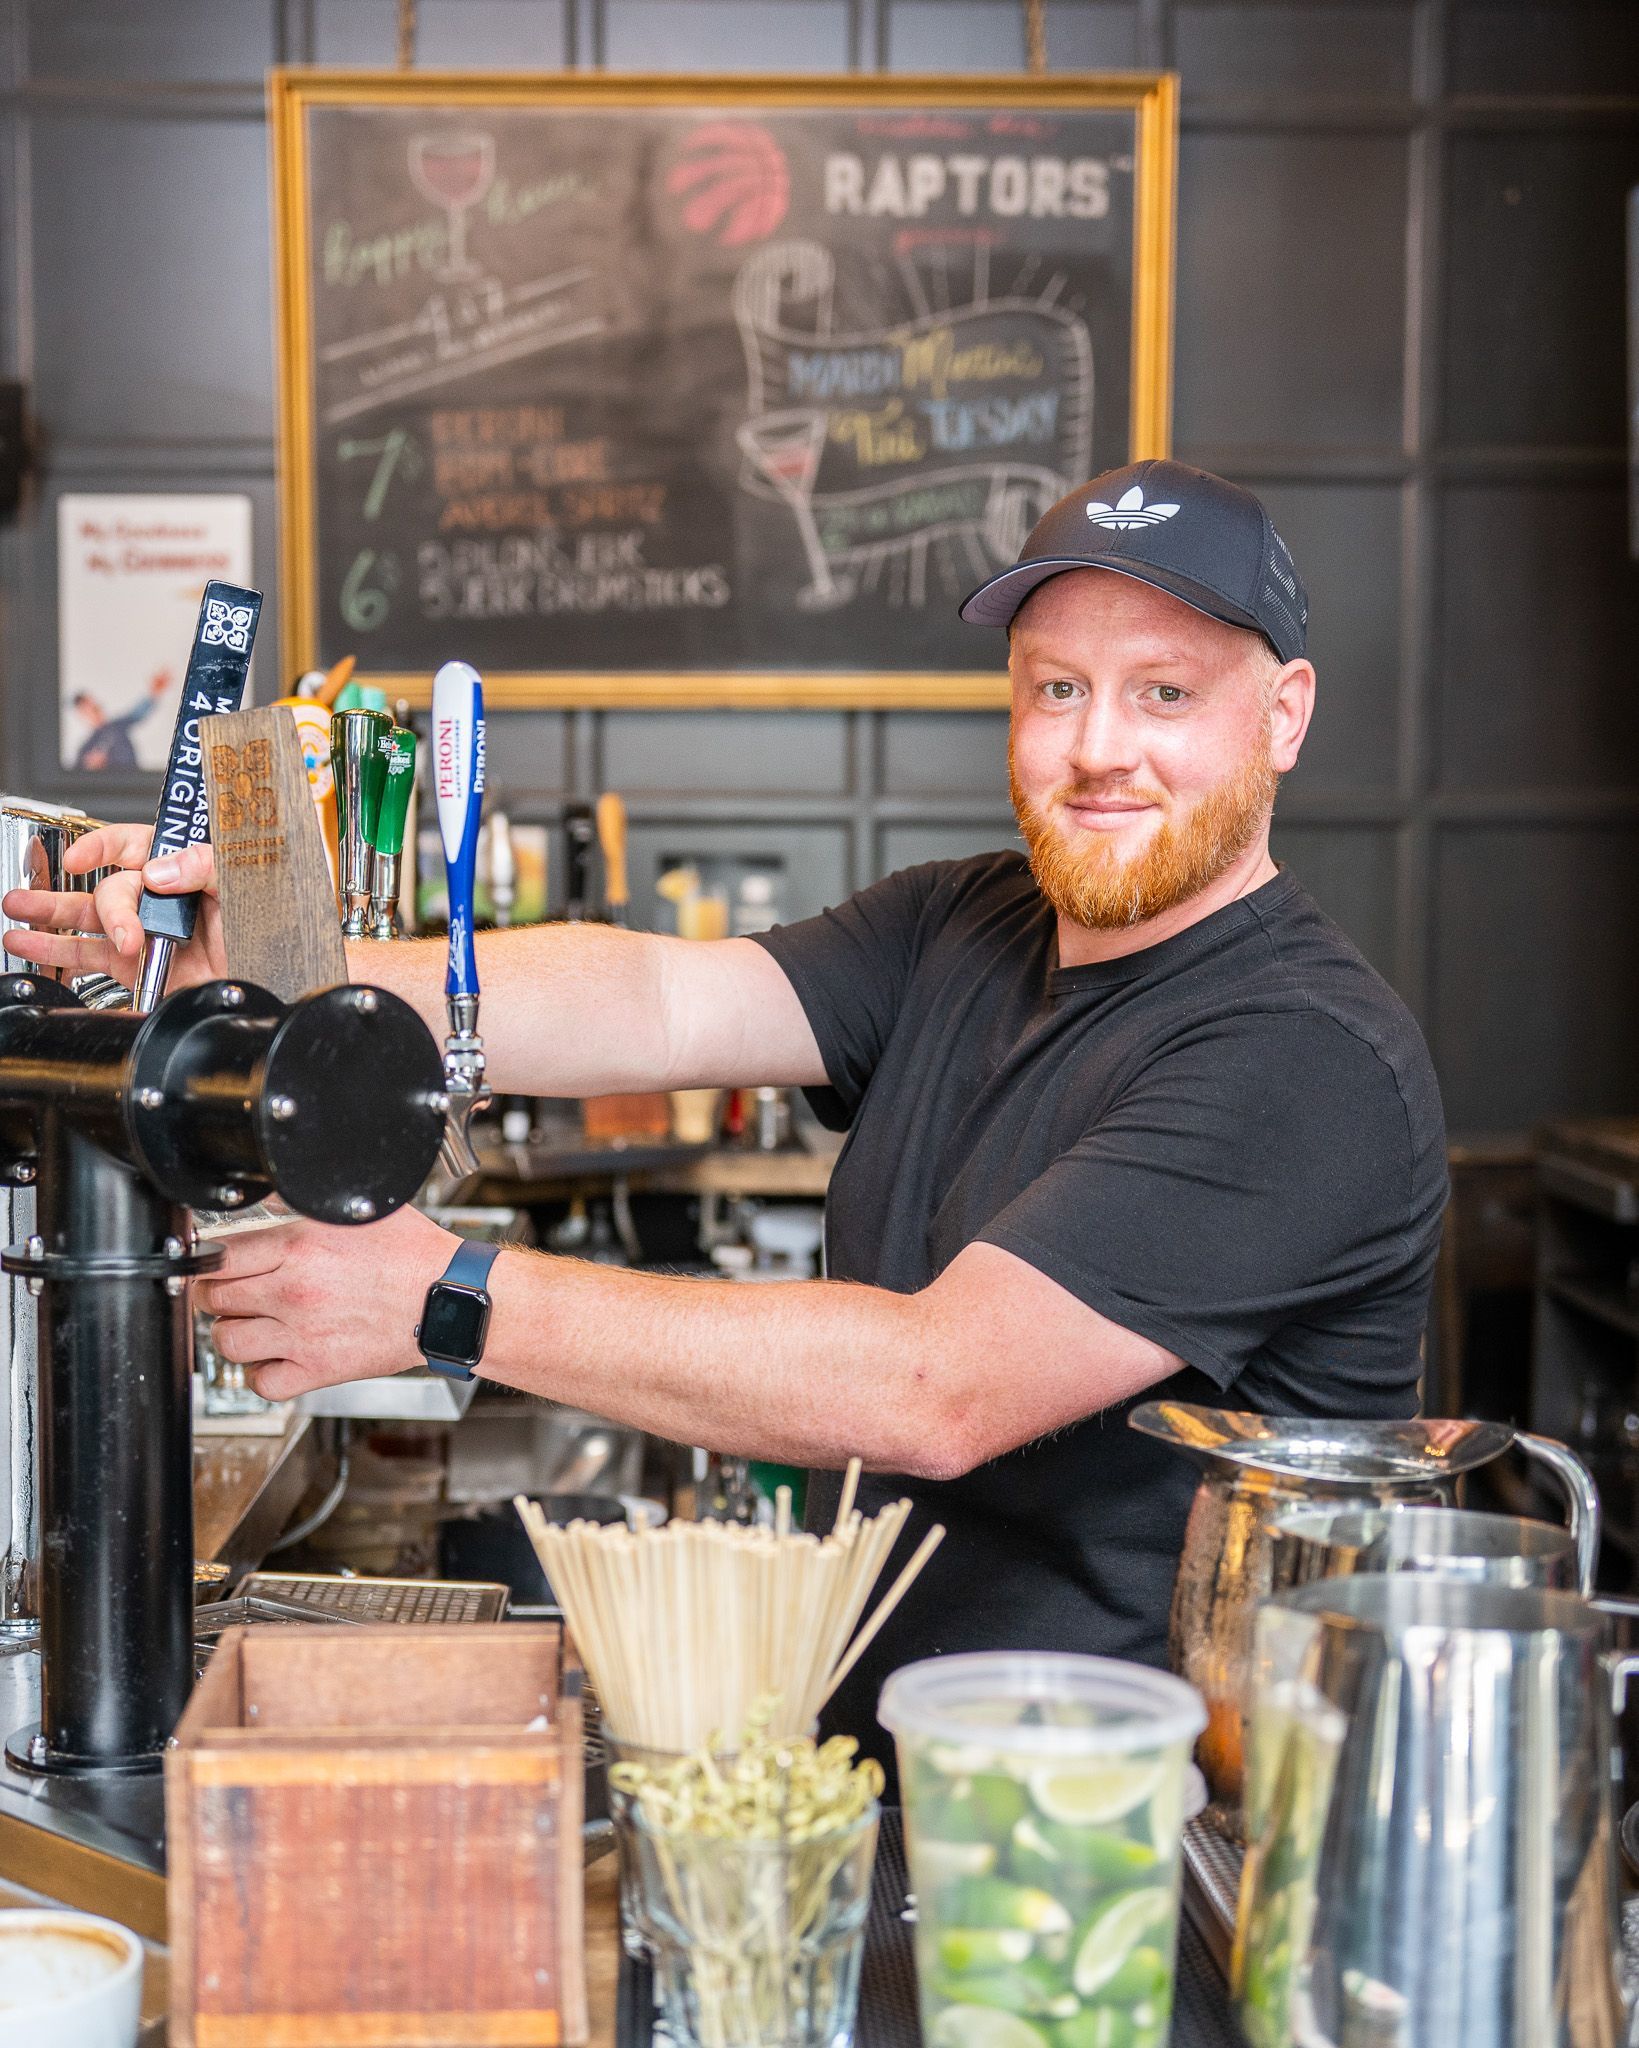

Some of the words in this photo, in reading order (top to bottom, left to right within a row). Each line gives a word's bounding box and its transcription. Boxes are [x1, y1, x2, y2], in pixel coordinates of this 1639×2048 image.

[825, 153, 1108, 216] RAPTORS
[189, 691, 212, 711] 4
[158, 719, 201, 858] ORIGINE
[439, 719, 453, 798] PERONI
